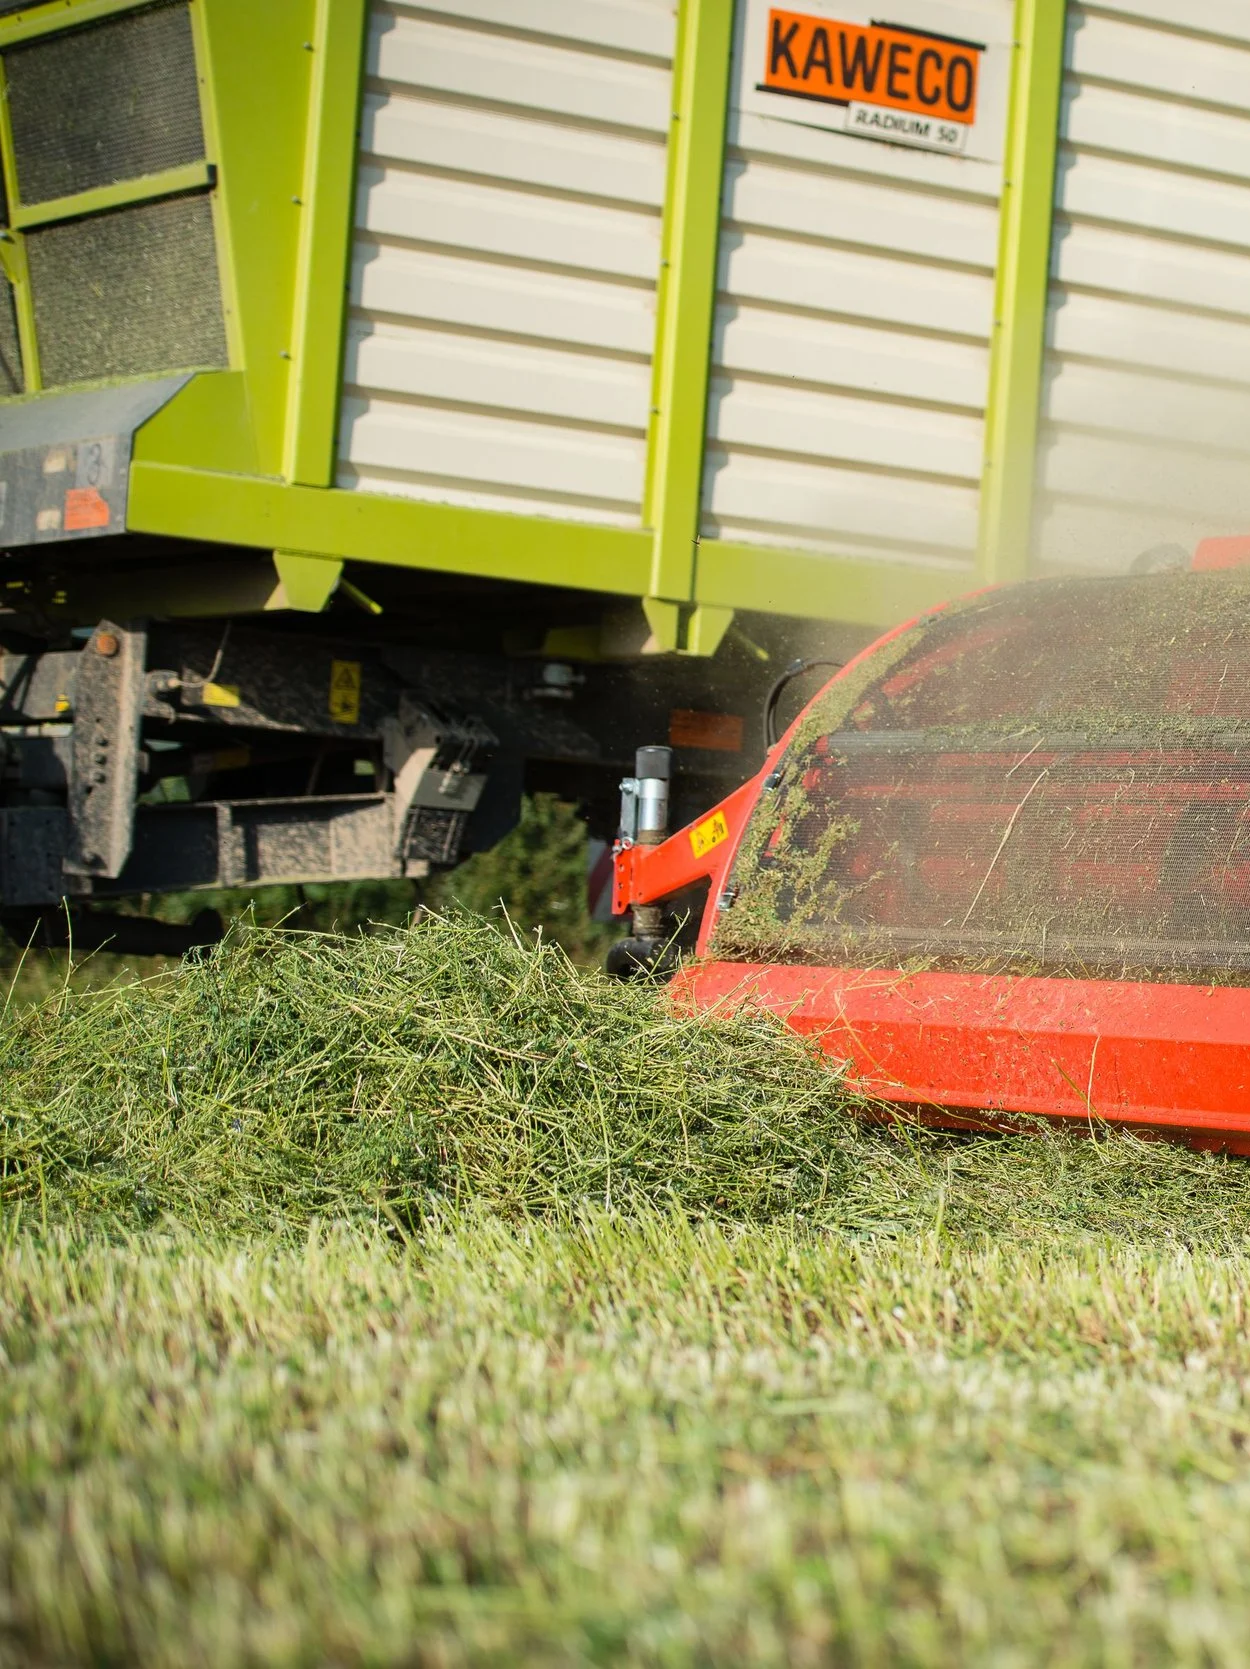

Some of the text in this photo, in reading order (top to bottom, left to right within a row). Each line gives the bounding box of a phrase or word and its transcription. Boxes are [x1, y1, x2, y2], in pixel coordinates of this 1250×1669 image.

[771, 19, 973, 112] KAWECO
[855, 111, 957, 144] RADIUM 50
